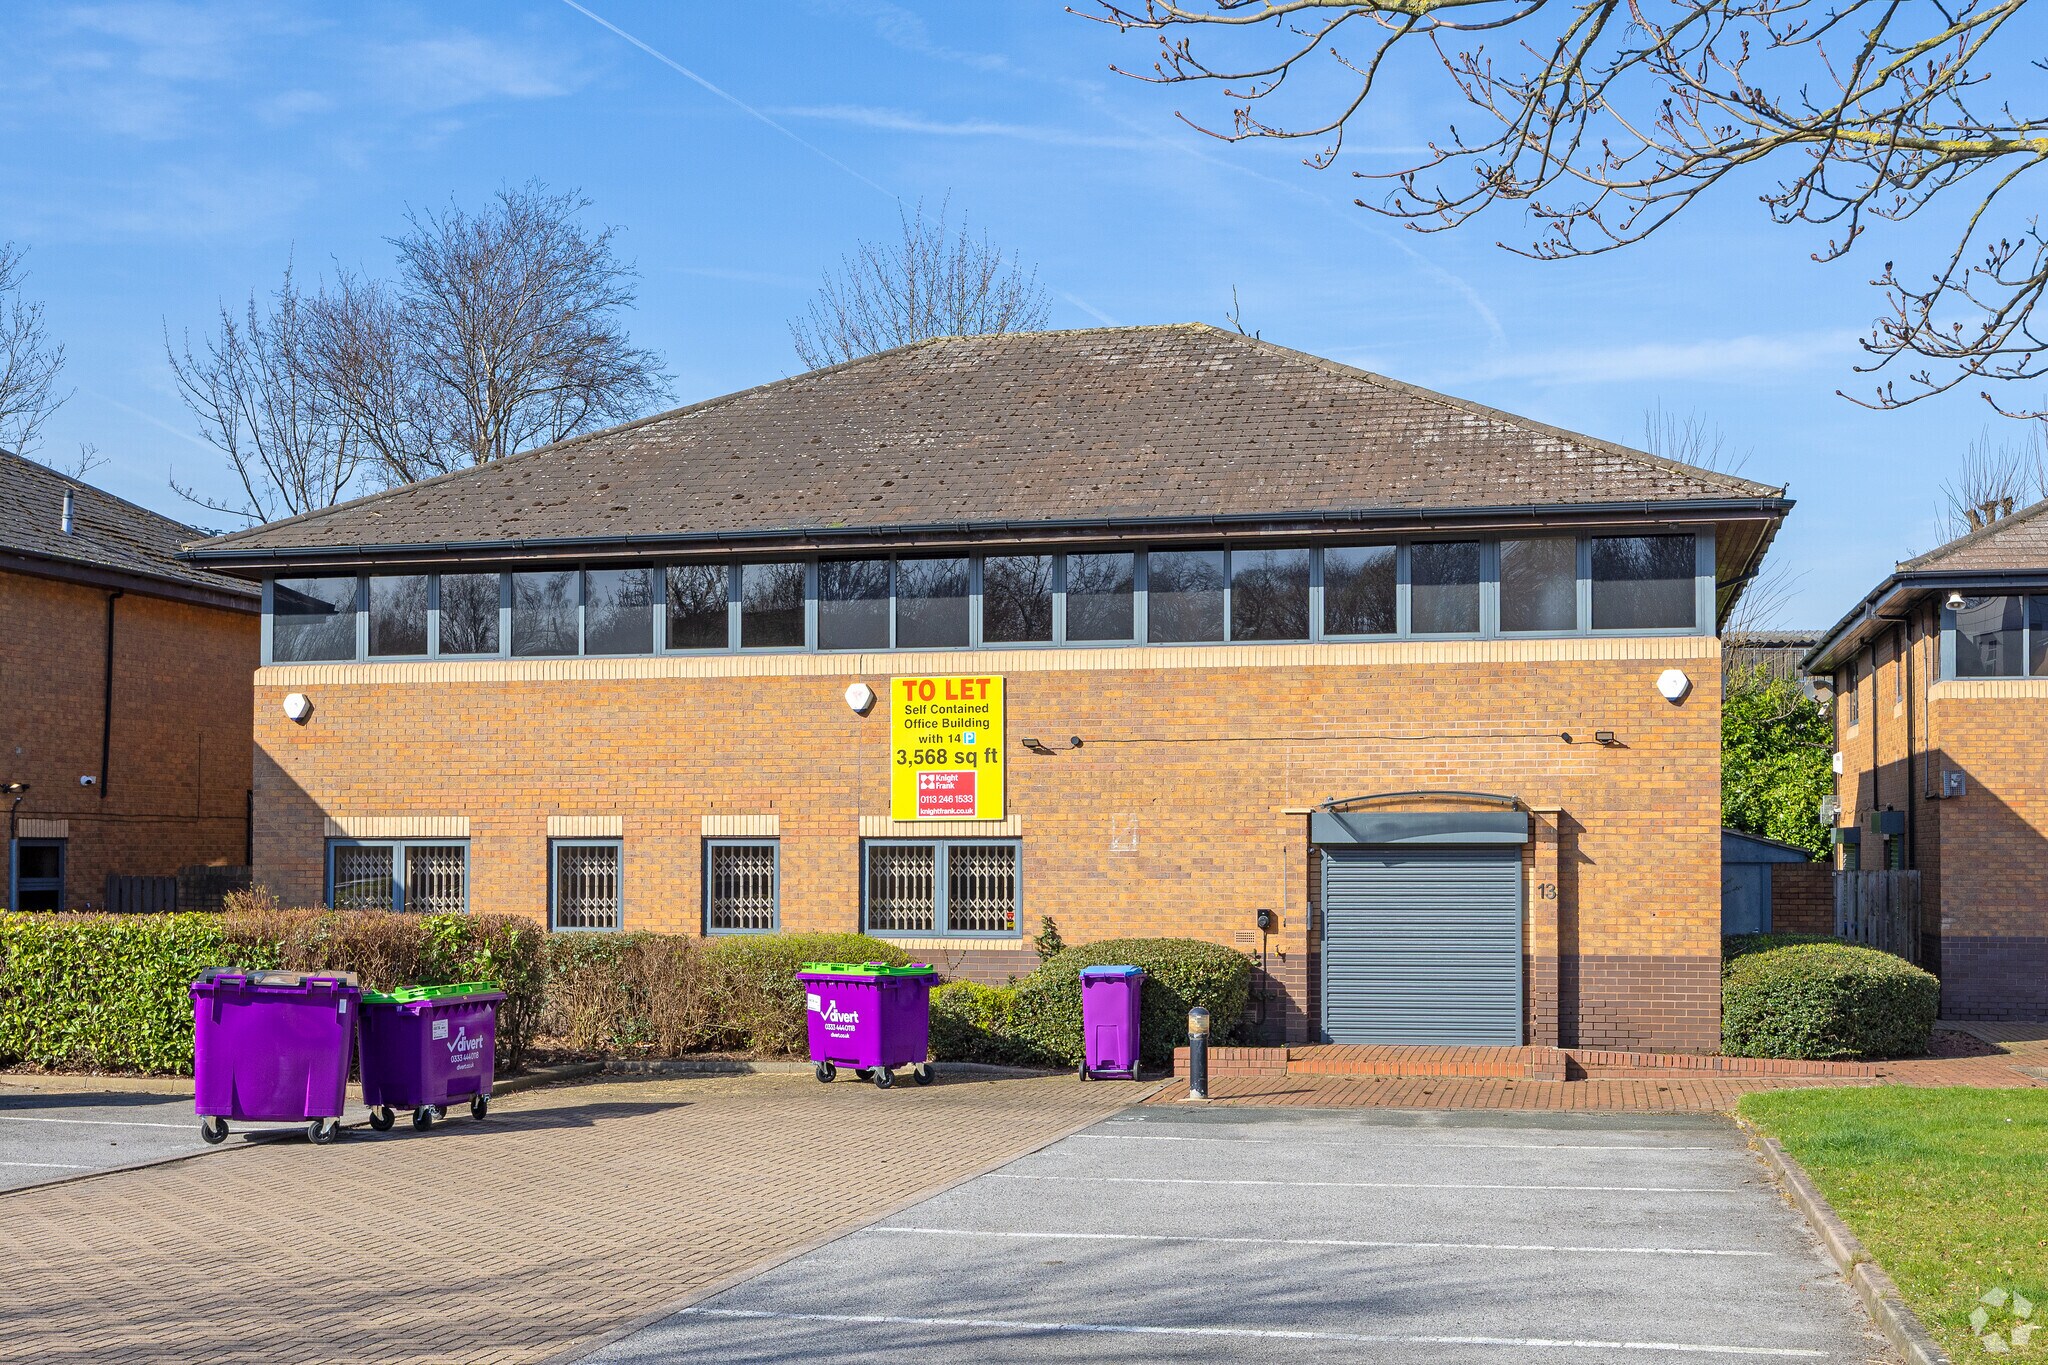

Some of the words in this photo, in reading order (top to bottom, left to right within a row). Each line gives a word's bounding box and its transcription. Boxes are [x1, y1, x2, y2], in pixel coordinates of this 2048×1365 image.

[903, 679, 936, 701] TO
[945, 678, 991, 701] LET
[905, 704, 927, 715] Self
[930, 703, 989, 714] Contained
[904, 718, 938, 729] Office
[942, 717, 990, 730] Building
[919, 733, 943, 744] with
[948, 733, 961, 743] 14
[896, 748, 948, 768] 3,568
[954, 750, 977, 768] sq
[984, 747, 998, 763] ft
[936, 774, 958, 783] Knight
[920, 795, 937, 804] 0113
[938, 795, 954, 803] 246
[955, 794, 973, 803] 1533
[920, 807, 974, 816] knightfrank.co.uk
[1537, 883, 1557, 900] 13
[830, 1009, 859, 1023] divert
[458, 1035, 483, 1051] divert
